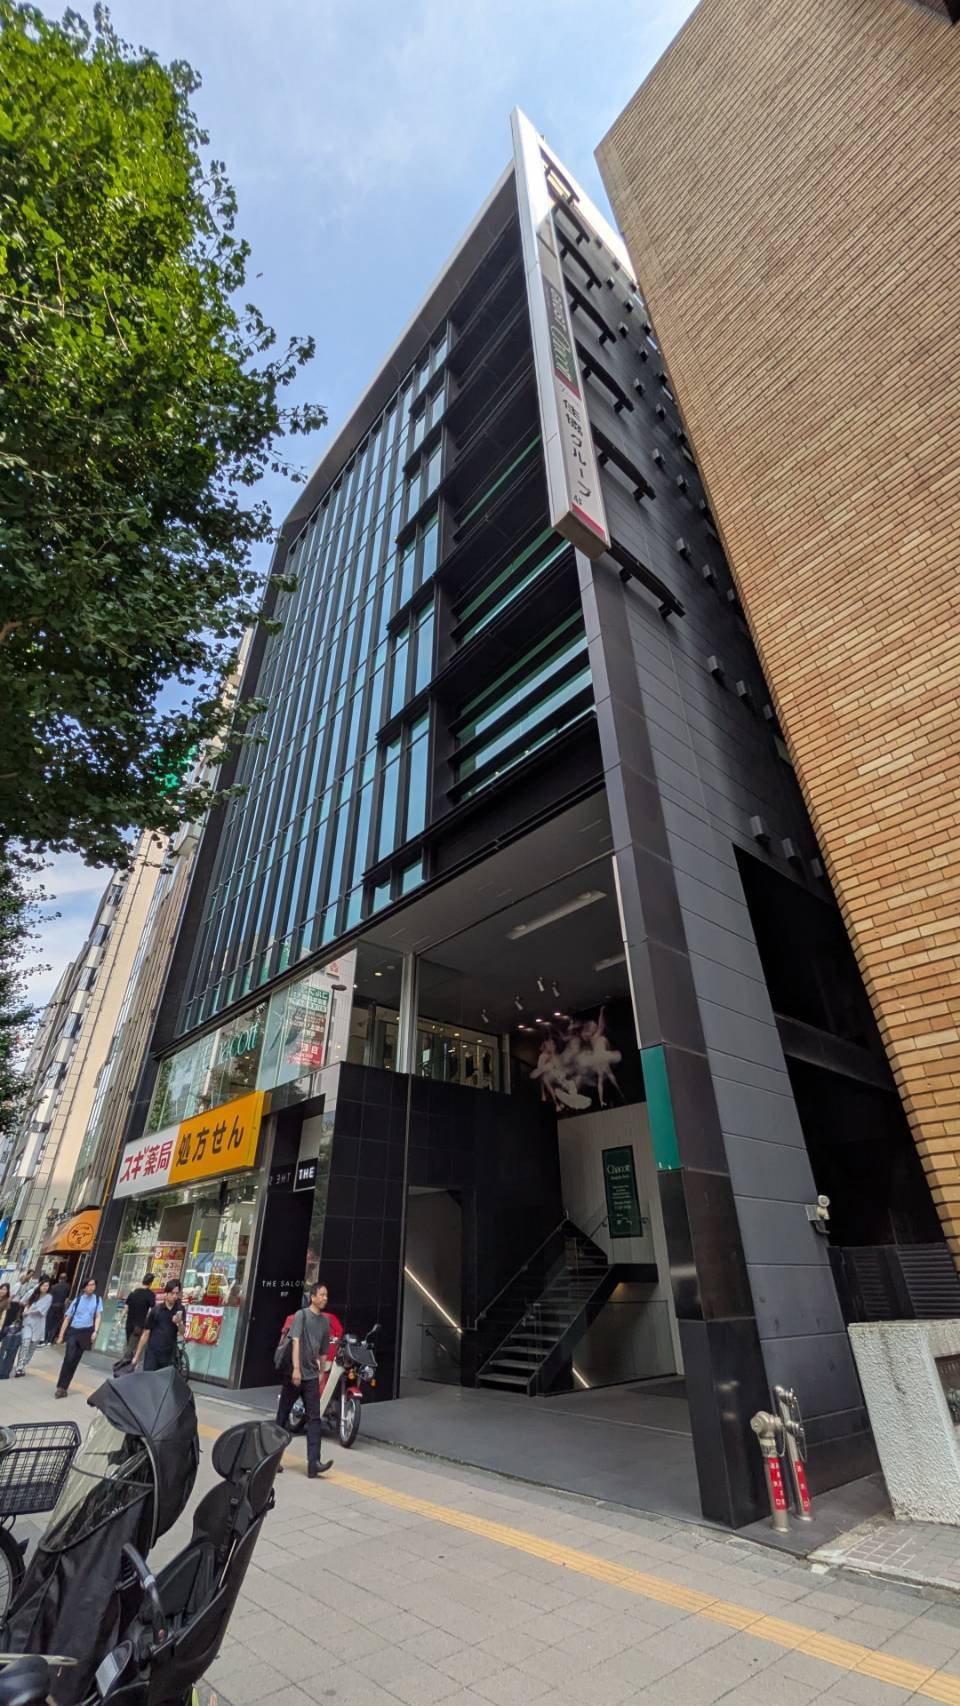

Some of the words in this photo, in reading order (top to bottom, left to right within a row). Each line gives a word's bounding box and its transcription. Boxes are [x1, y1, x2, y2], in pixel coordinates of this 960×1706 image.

[176, 1115, 245, 1168] 処方せん
[119, 1139, 174, 1184] スギ薬局
[298, 1166, 315, 1180] THE
[262, 1280, 277, 1288] THE
